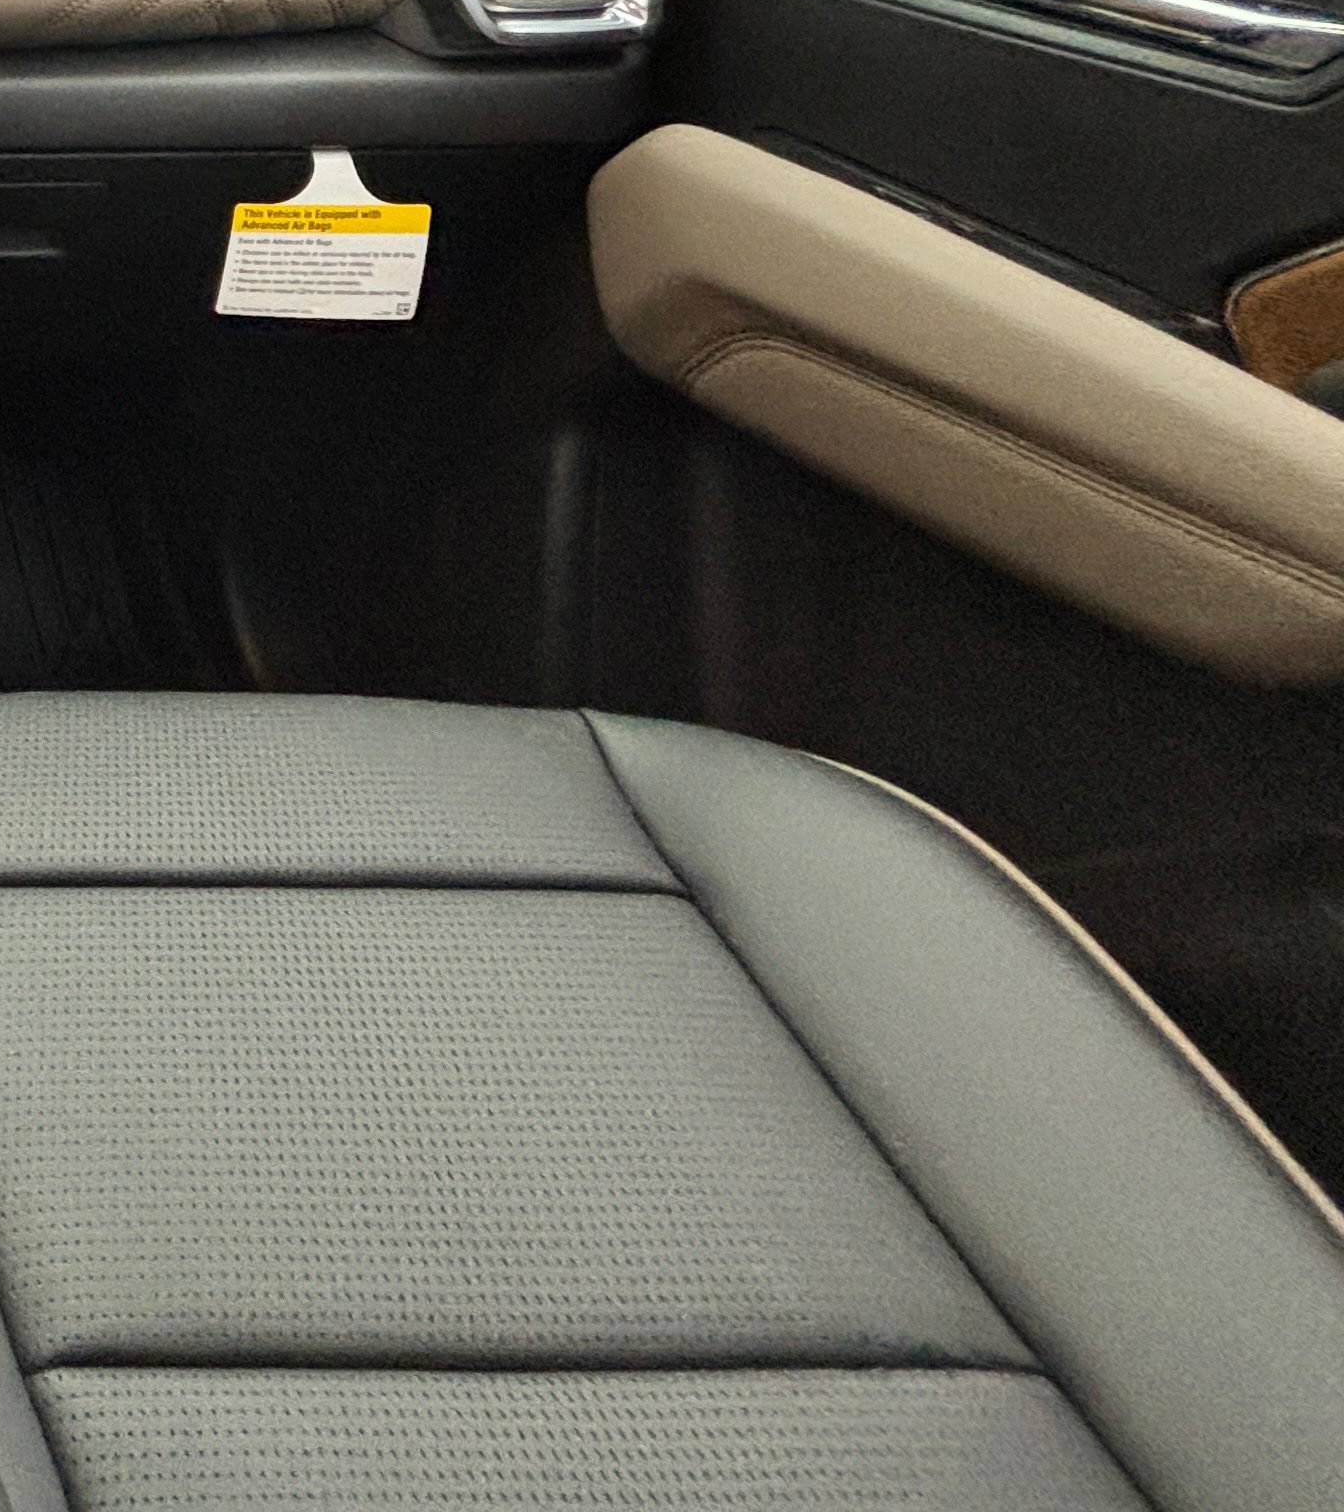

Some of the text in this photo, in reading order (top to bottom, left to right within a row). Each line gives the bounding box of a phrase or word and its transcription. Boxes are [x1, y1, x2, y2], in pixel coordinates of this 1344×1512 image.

[244, 209, 381, 220] This Vehicle is Equipped with
[242, 221, 332, 232] Advanced Air Bags
